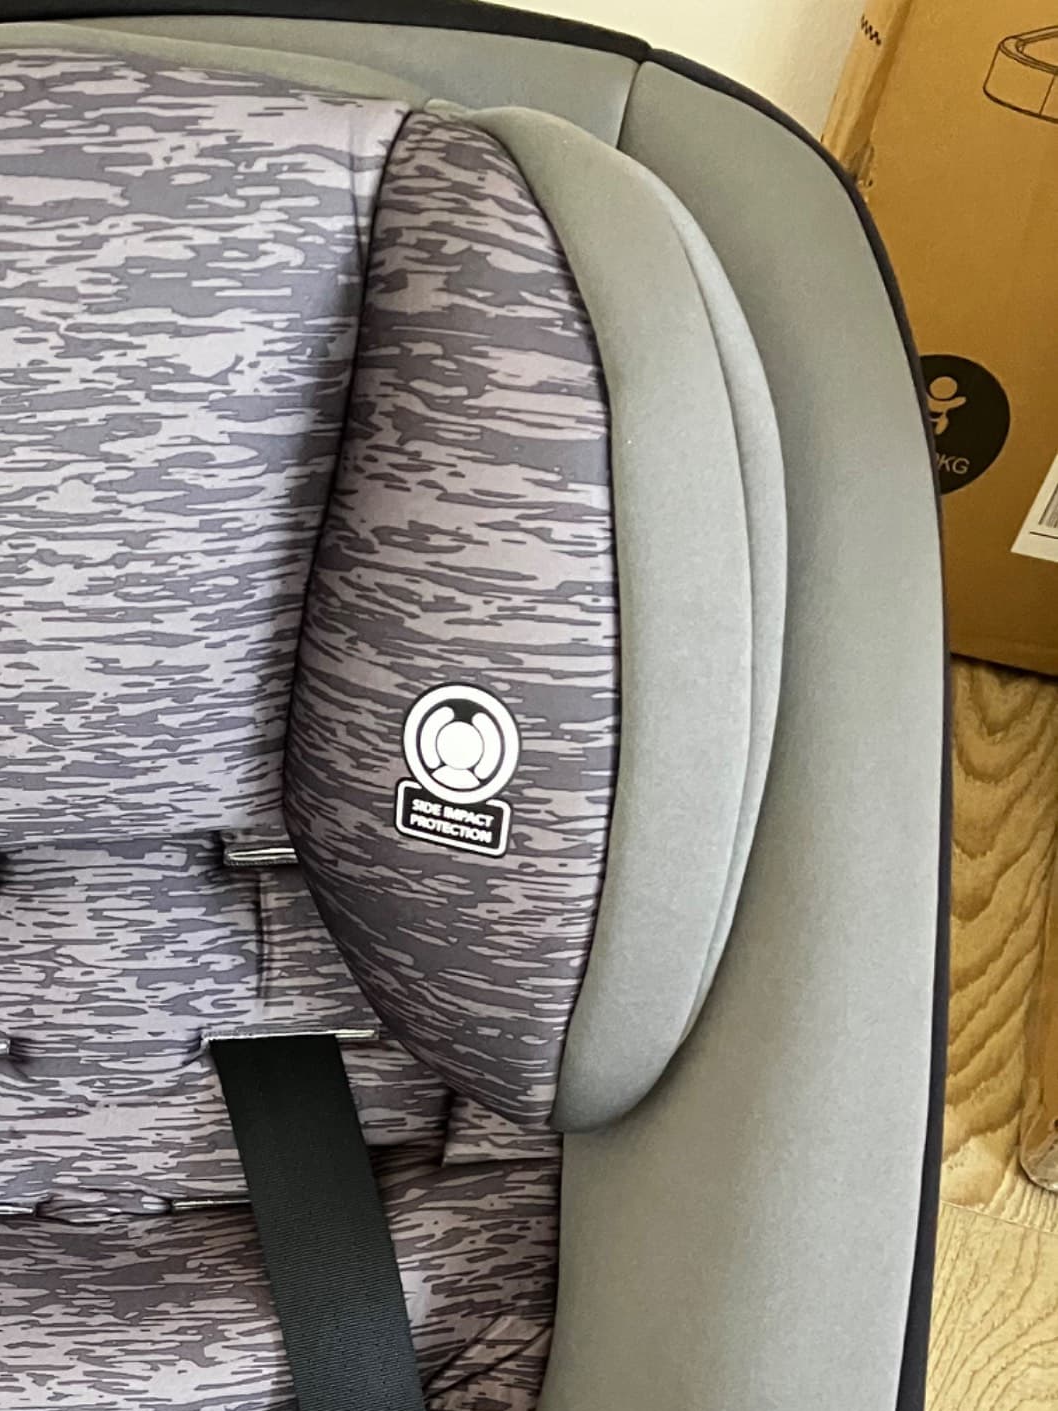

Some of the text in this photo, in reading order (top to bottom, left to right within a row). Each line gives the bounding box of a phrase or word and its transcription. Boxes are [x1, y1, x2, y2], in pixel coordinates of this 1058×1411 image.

[412, 799, 494, 827] SIDE IMPACT
[410, 814, 492, 843] PROTECTION
